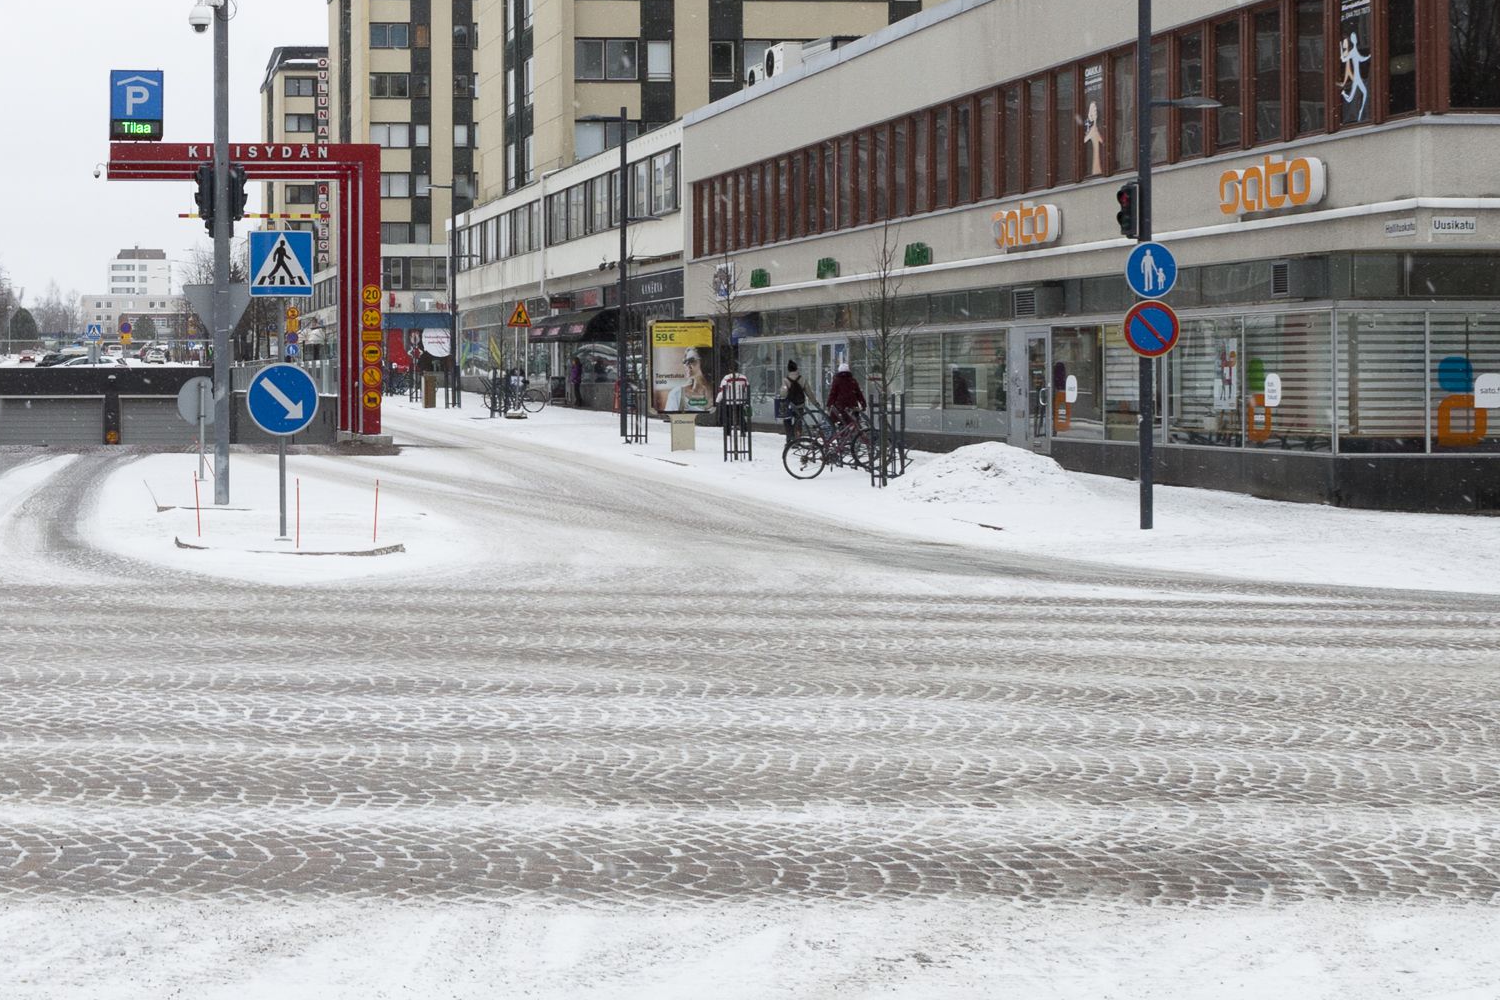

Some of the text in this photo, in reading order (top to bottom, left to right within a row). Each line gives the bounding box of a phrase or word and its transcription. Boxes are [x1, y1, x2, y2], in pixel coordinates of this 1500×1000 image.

[126, 86, 149, 115] P
[122, 122, 151, 134] Tilaa
[188, 145, 328, 158] KIISYDÄN
[1219, 155, 1311, 215] sato
[991, 201, 1049, 249] sato
[1433, 220, 1474, 230] Uusikatu
[365, 290, 378, 299] 20
